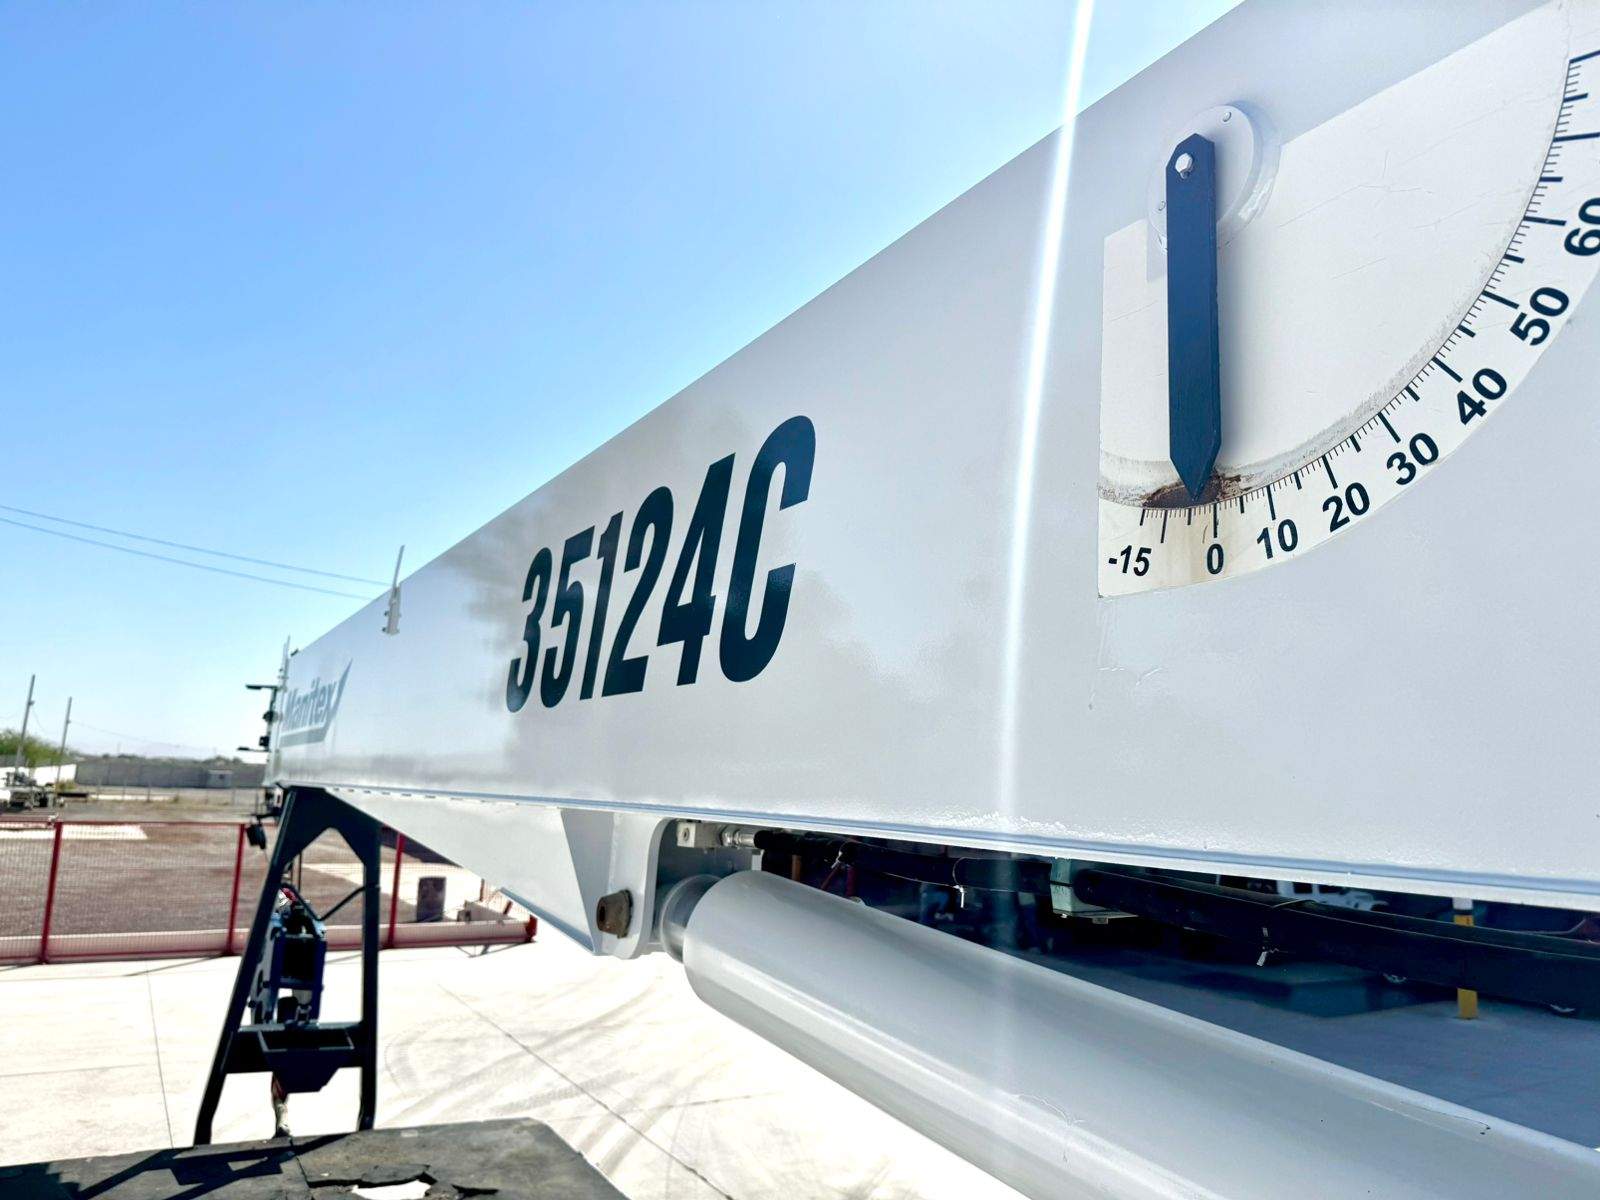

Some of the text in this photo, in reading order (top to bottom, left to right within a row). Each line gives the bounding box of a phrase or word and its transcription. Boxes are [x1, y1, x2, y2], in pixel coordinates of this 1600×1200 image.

[1509, 286, 1570, 346] 50
[1456, 368, 1508, 425] 40
[1386, 432, 1440, 486] 30
[1322, 482, 1371, 532] 20
[506, 415, 816, 713] 35124C
[1108, 544, 1152, 577] -15
[1206, 543, 1225, 575] 0
[1256, 518, 1299, 560] 10
